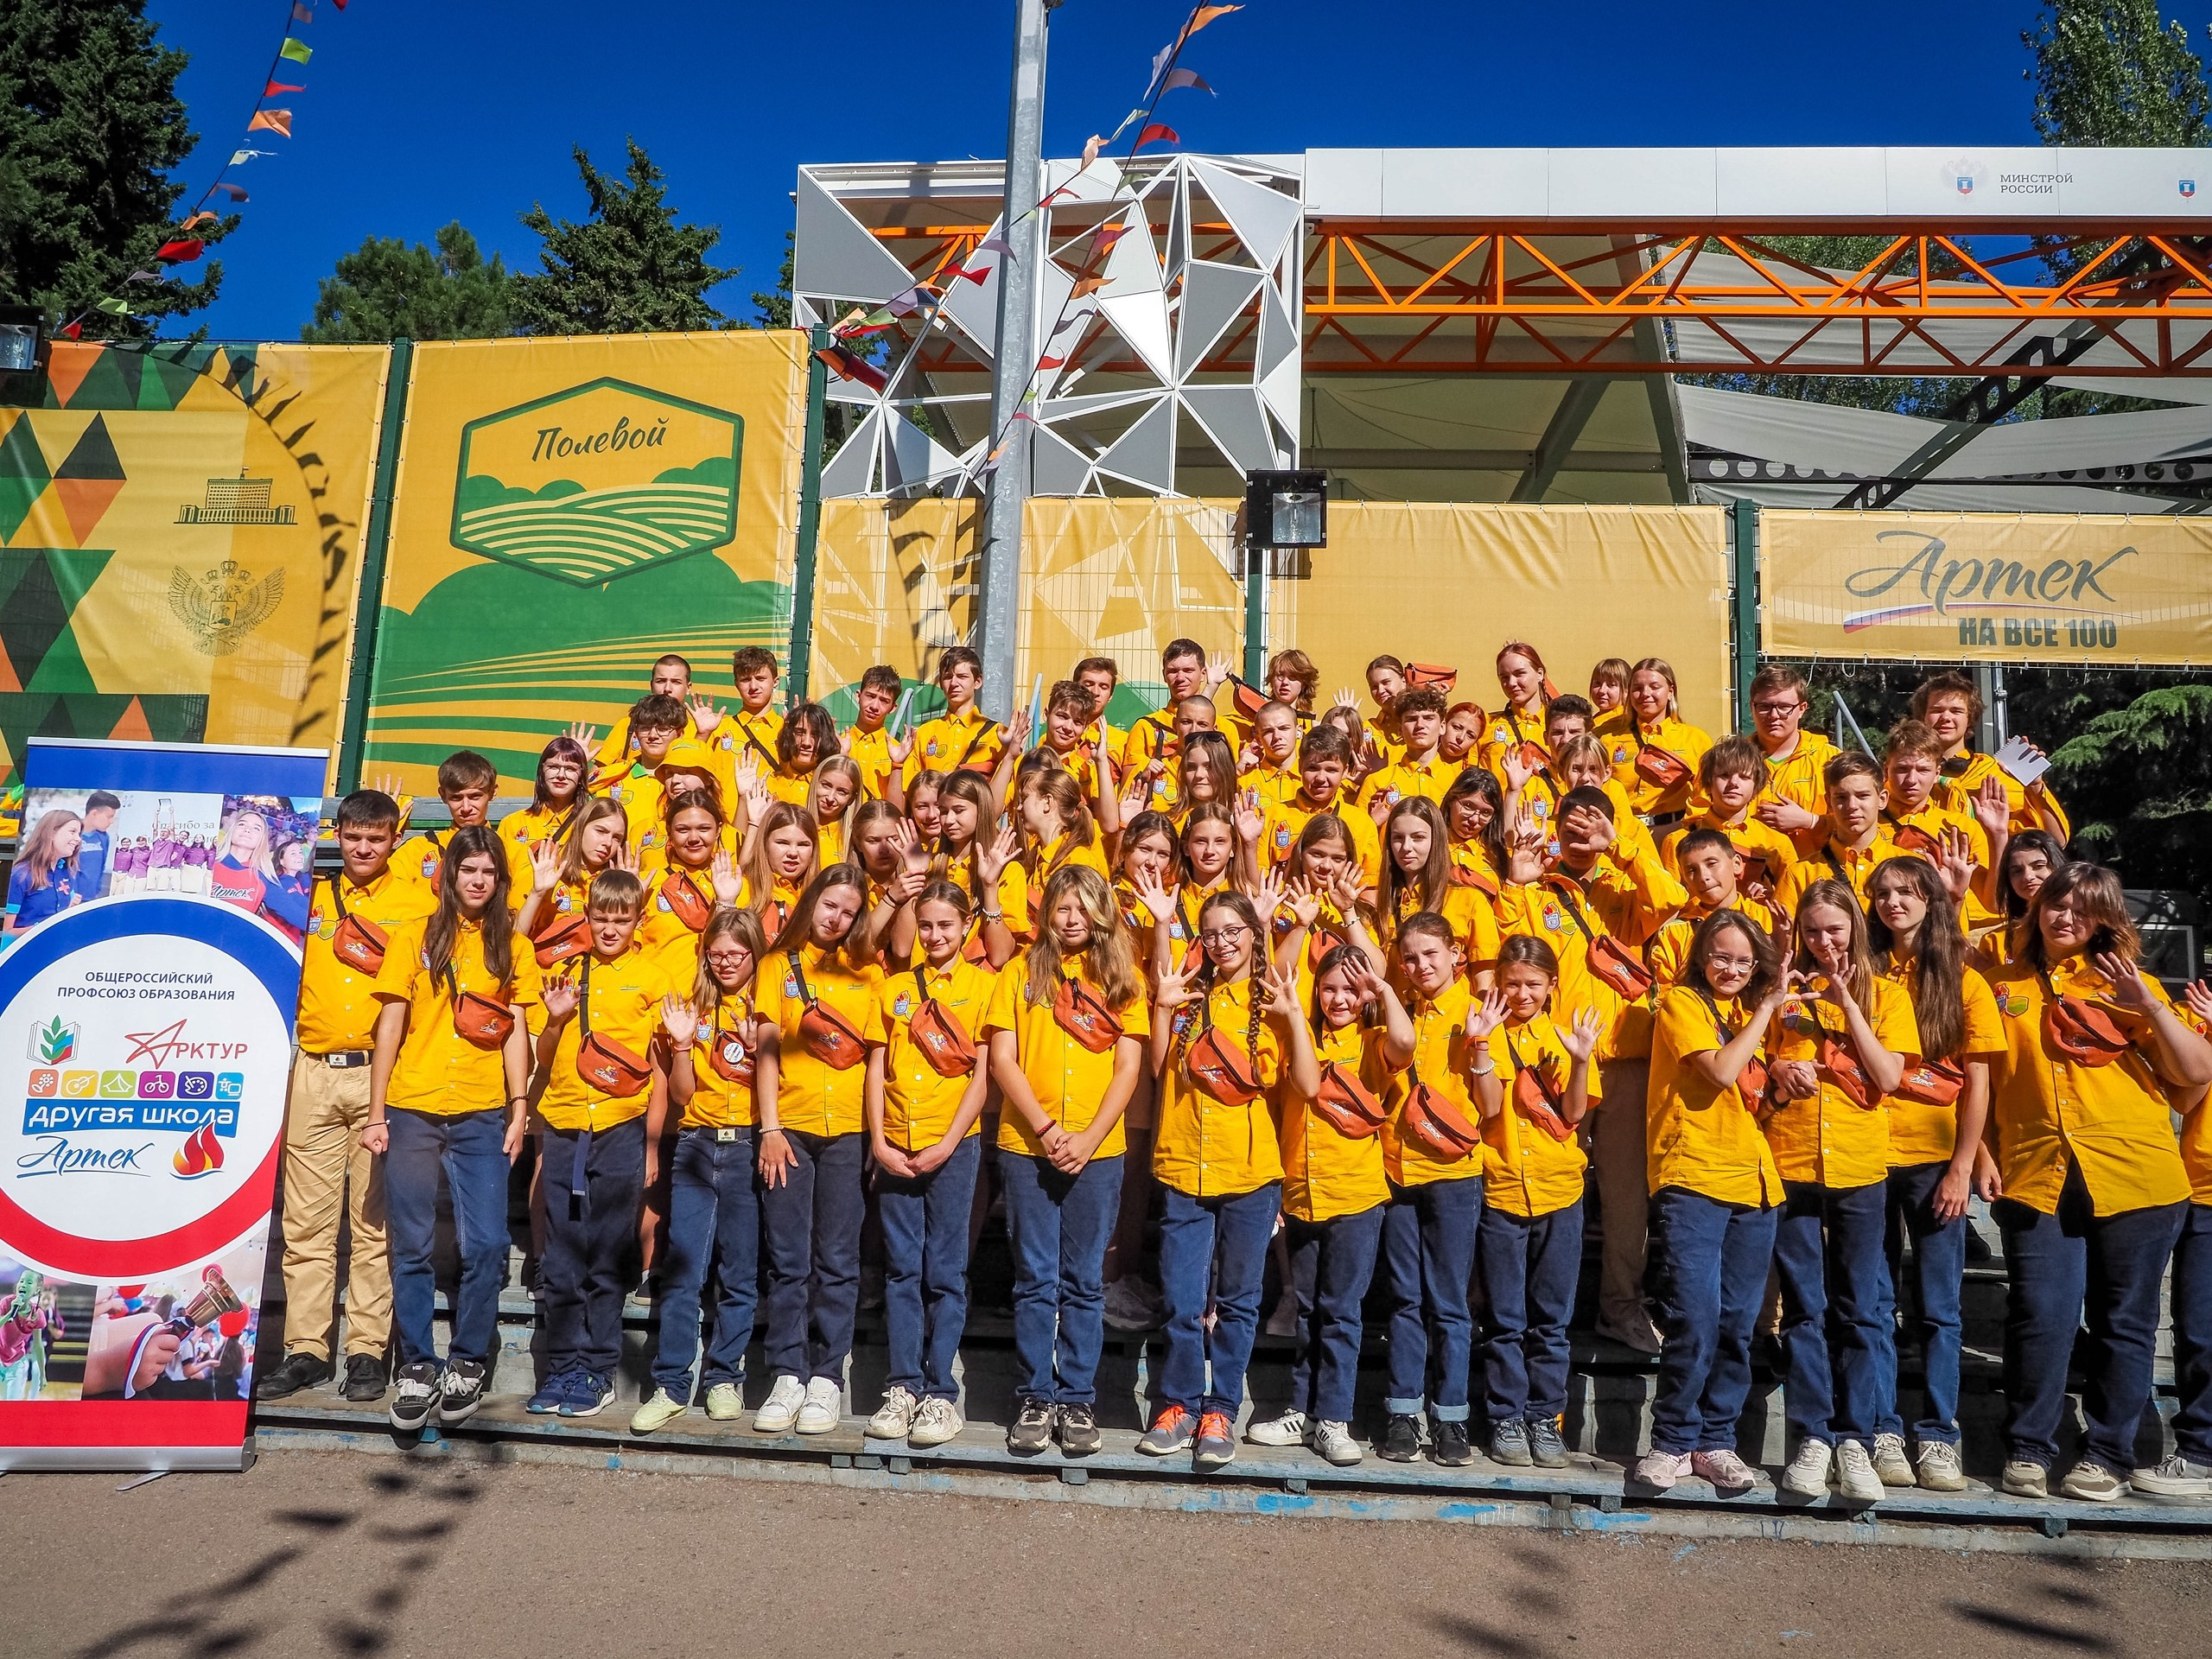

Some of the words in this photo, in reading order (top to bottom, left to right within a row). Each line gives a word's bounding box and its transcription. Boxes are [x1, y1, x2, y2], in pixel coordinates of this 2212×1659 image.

[2000, 173, 2073, 183] МИНСТРОЙ
[2000, 185, 2053, 194] РОССИИ
[531, 416, 670, 462] Полевой
[1844, 530, 2139, 616] Артек
[1958, 617, 1997, 646] НА
[2004, 618, 2059, 648] ВСЕ
[2064, 619, 2117, 649] 100
[85, 971, 213, 984] ОБЩЕРОССИЙСКИЙ
[57, 987, 136, 999] ПРОФСОЮЗ
[138, 988, 235, 1001] ОБРАЗОВАНИЯ
[16, 1135, 155, 1175] Артек
